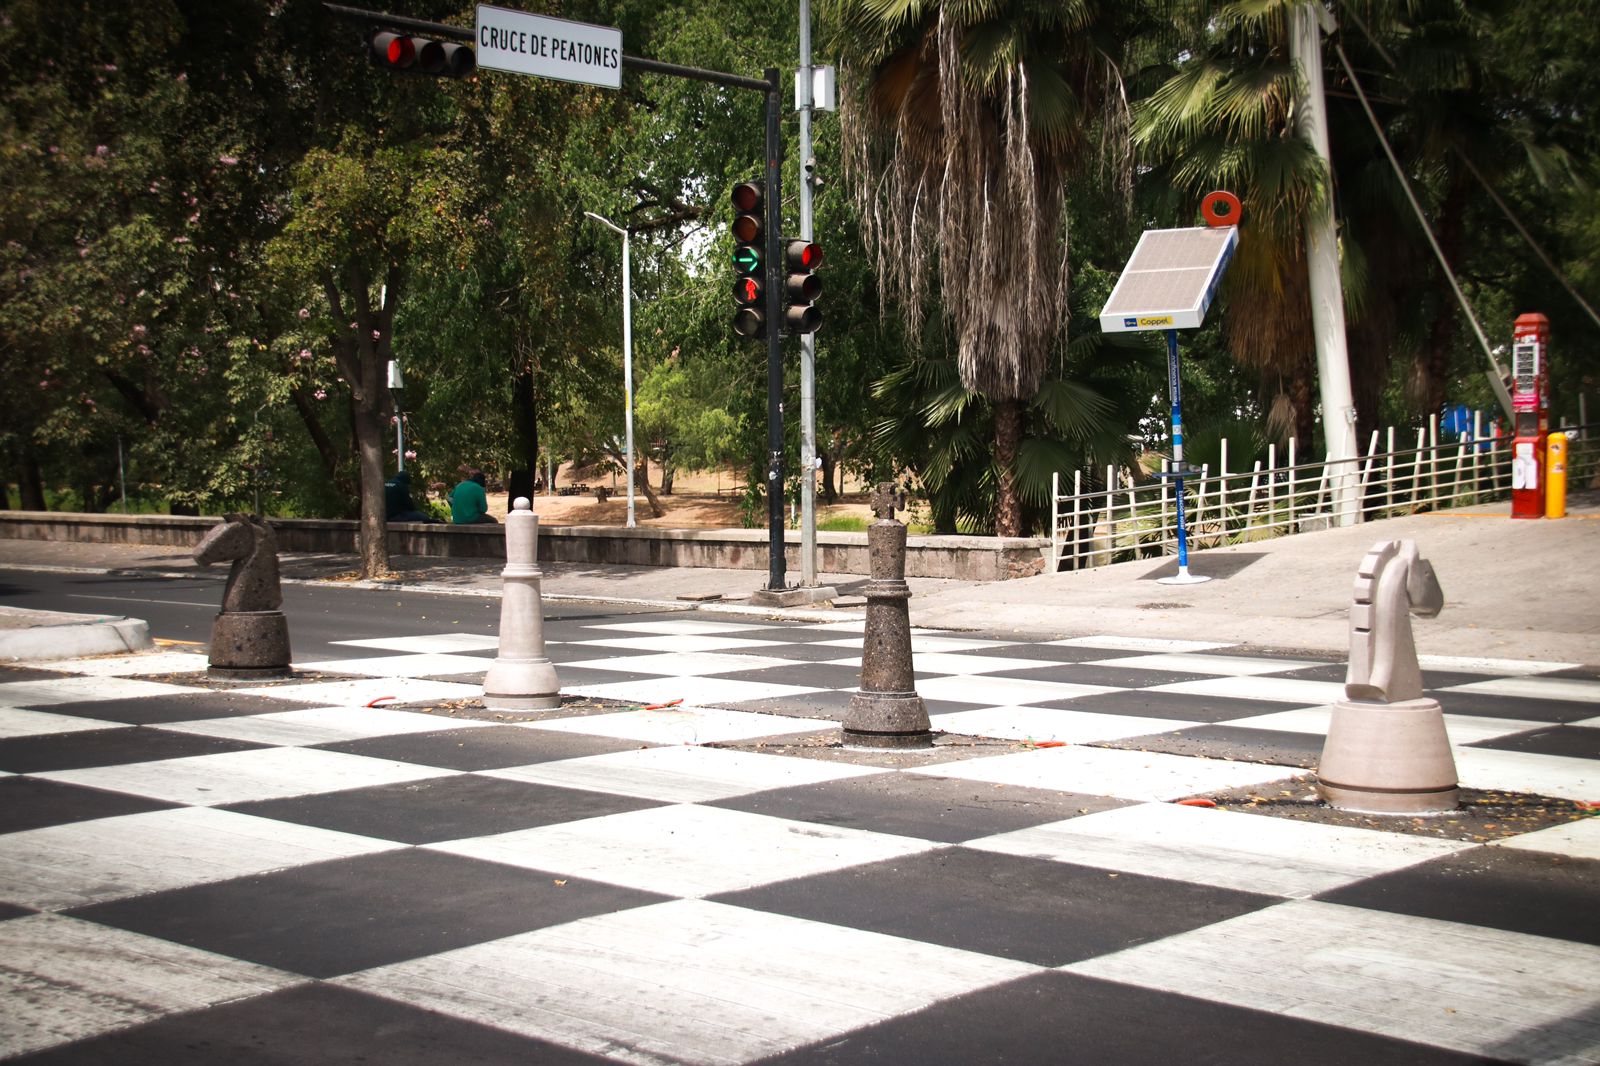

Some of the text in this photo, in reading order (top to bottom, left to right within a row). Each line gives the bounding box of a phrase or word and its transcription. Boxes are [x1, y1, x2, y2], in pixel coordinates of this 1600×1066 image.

[480, 25, 618, 69] CRUCE DE PEATONES
